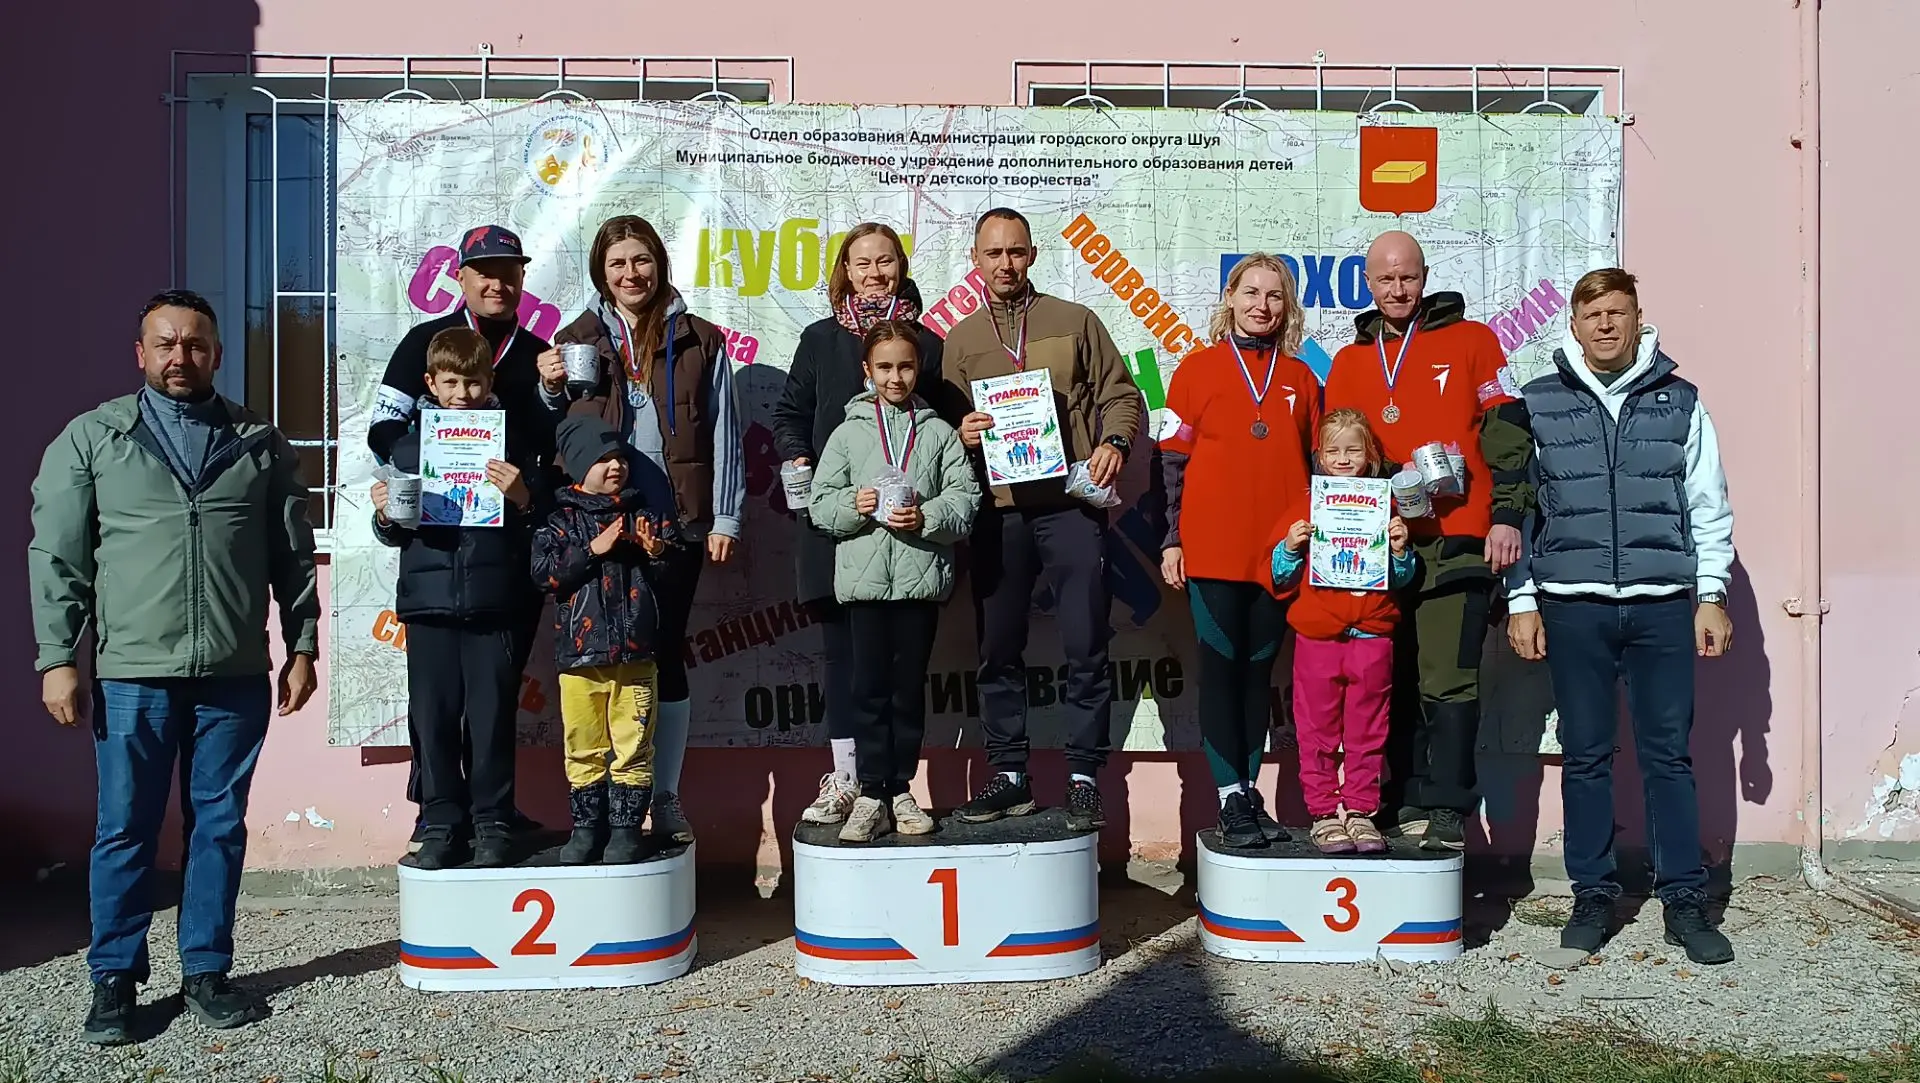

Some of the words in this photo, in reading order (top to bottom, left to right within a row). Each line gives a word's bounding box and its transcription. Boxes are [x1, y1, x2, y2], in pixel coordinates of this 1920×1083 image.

[750, 128, 798, 143] Отдел
[803, 128, 905, 144] образования
[909, 130, 1035, 146] Администрации
[1040, 134, 1127, 147] городского
[1131, 134, 1183, 148] округа
[1188, 132, 1221, 148] Шуя
[676, 150, 802, 166] Муниципальное
[807, 151, 895, 167] бюджетное
[900, 156, 995, 169] учреждение
[998, 157, 1138, 170] дополнительного
[1143, 157, 1244, 171] образования
[1249, 157, 1293, 172] детей
[930, 174, 998, 187] детского
[695, 218, 913, 296] куб
[988, 387, 1040, 405] ГРАМОТА
[437, 427, 492, 440] ГРАМОТА
[1325, 493, 1378, 508] ГРАМОТА
[684, 598, 814, 669] танция
[927, 867, 959, 946] 1
[1323, 877, 1361, 933] 3
[511, 888, 557, 956] 2
